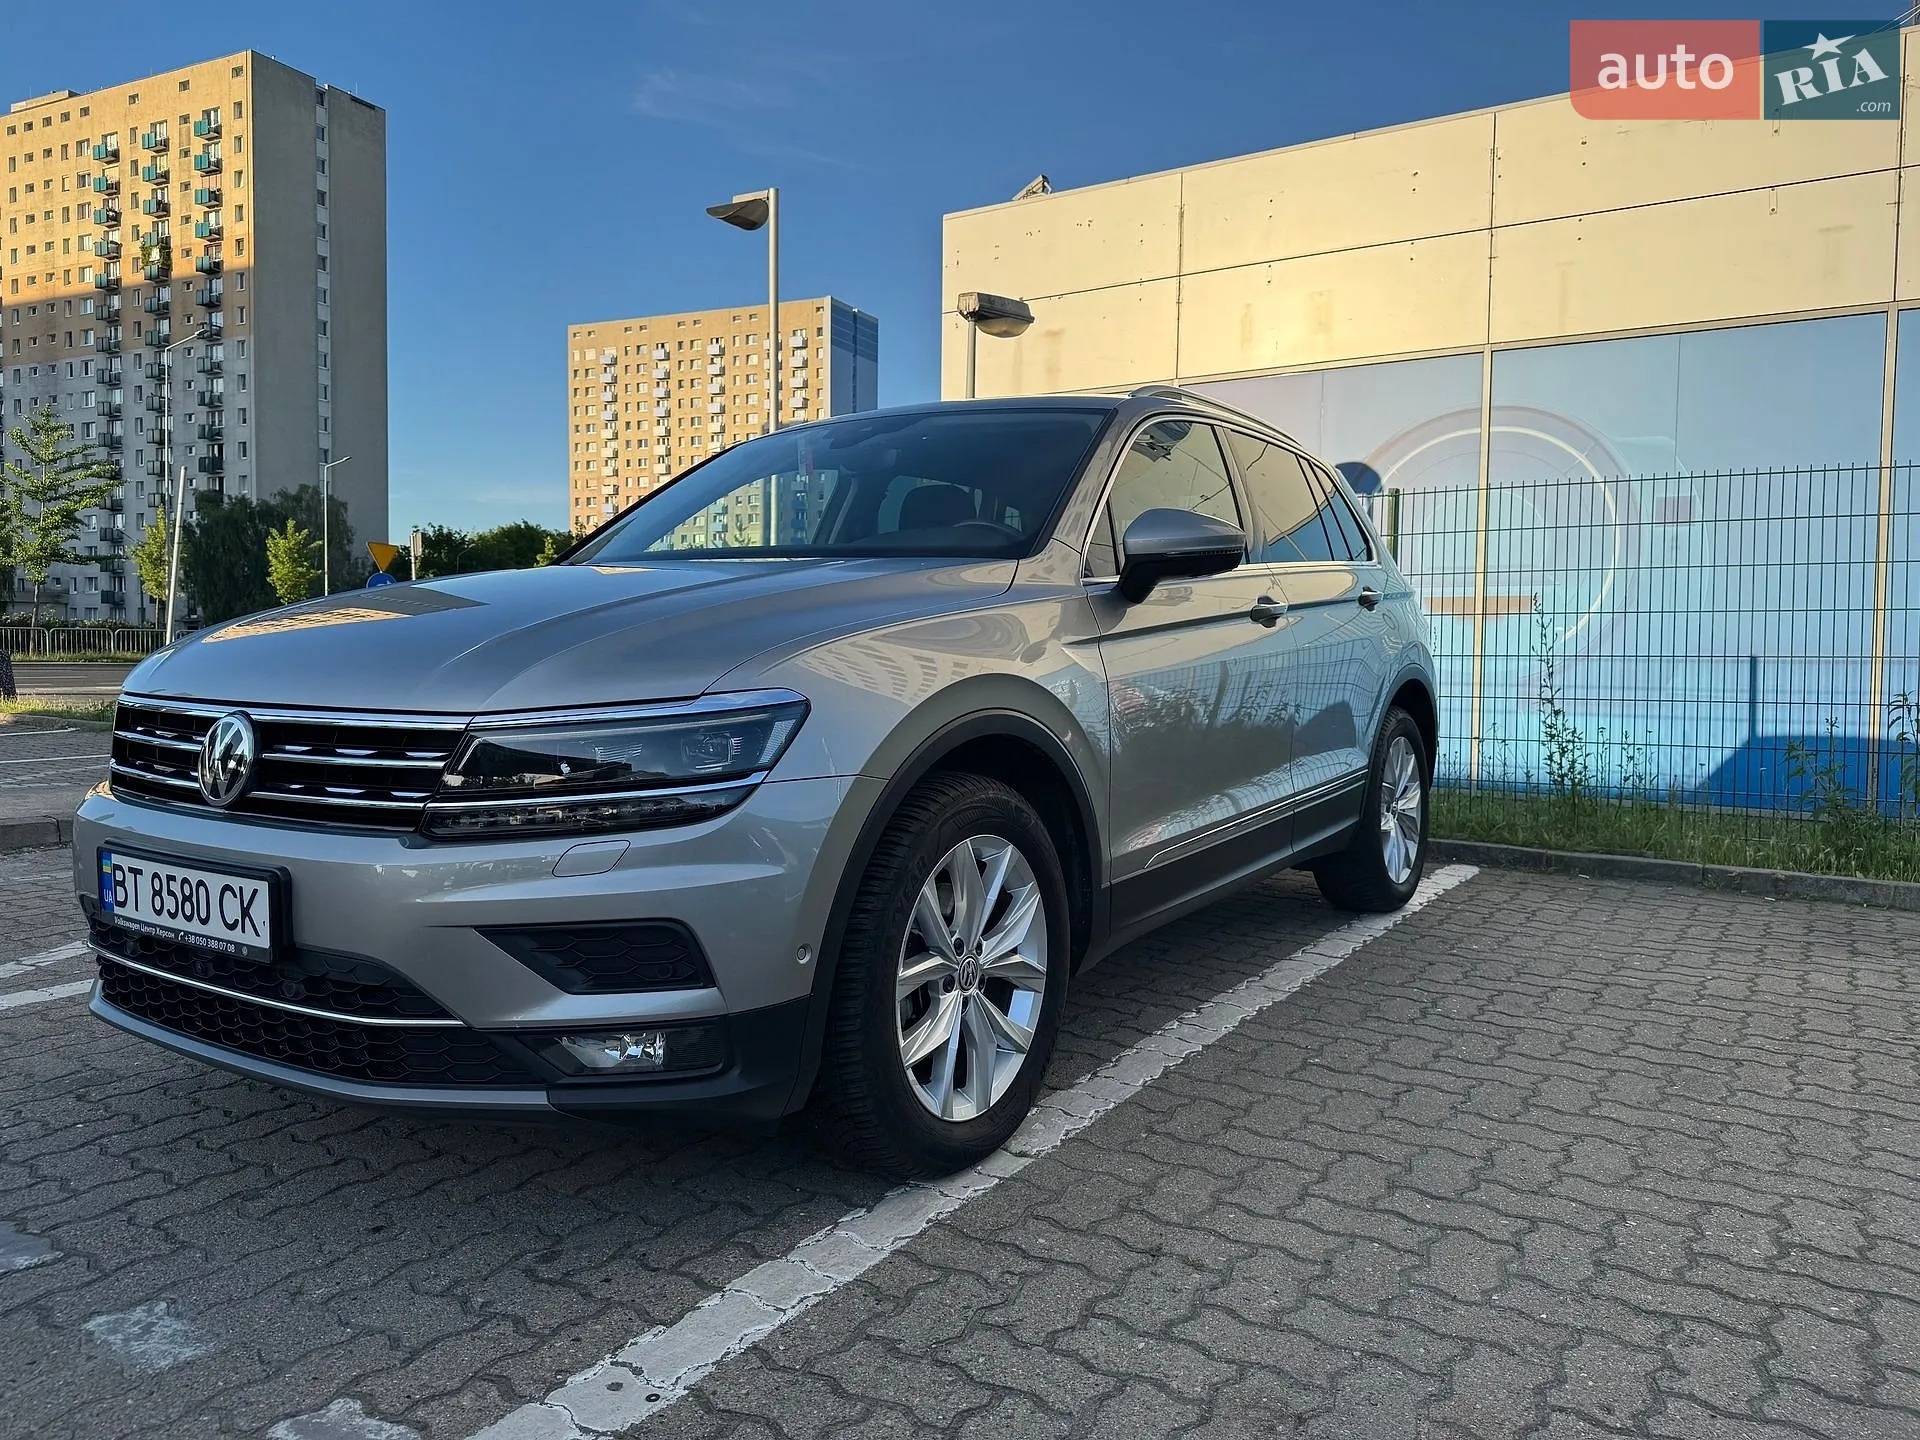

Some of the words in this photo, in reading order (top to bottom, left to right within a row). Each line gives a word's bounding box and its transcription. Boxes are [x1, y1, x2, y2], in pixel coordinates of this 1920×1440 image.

[103, 888, 113, 903] UA
[112, 862, 143, 912] BT
[151, 871, 210, 926] 8580
[219, 883, 261, 937] CK
